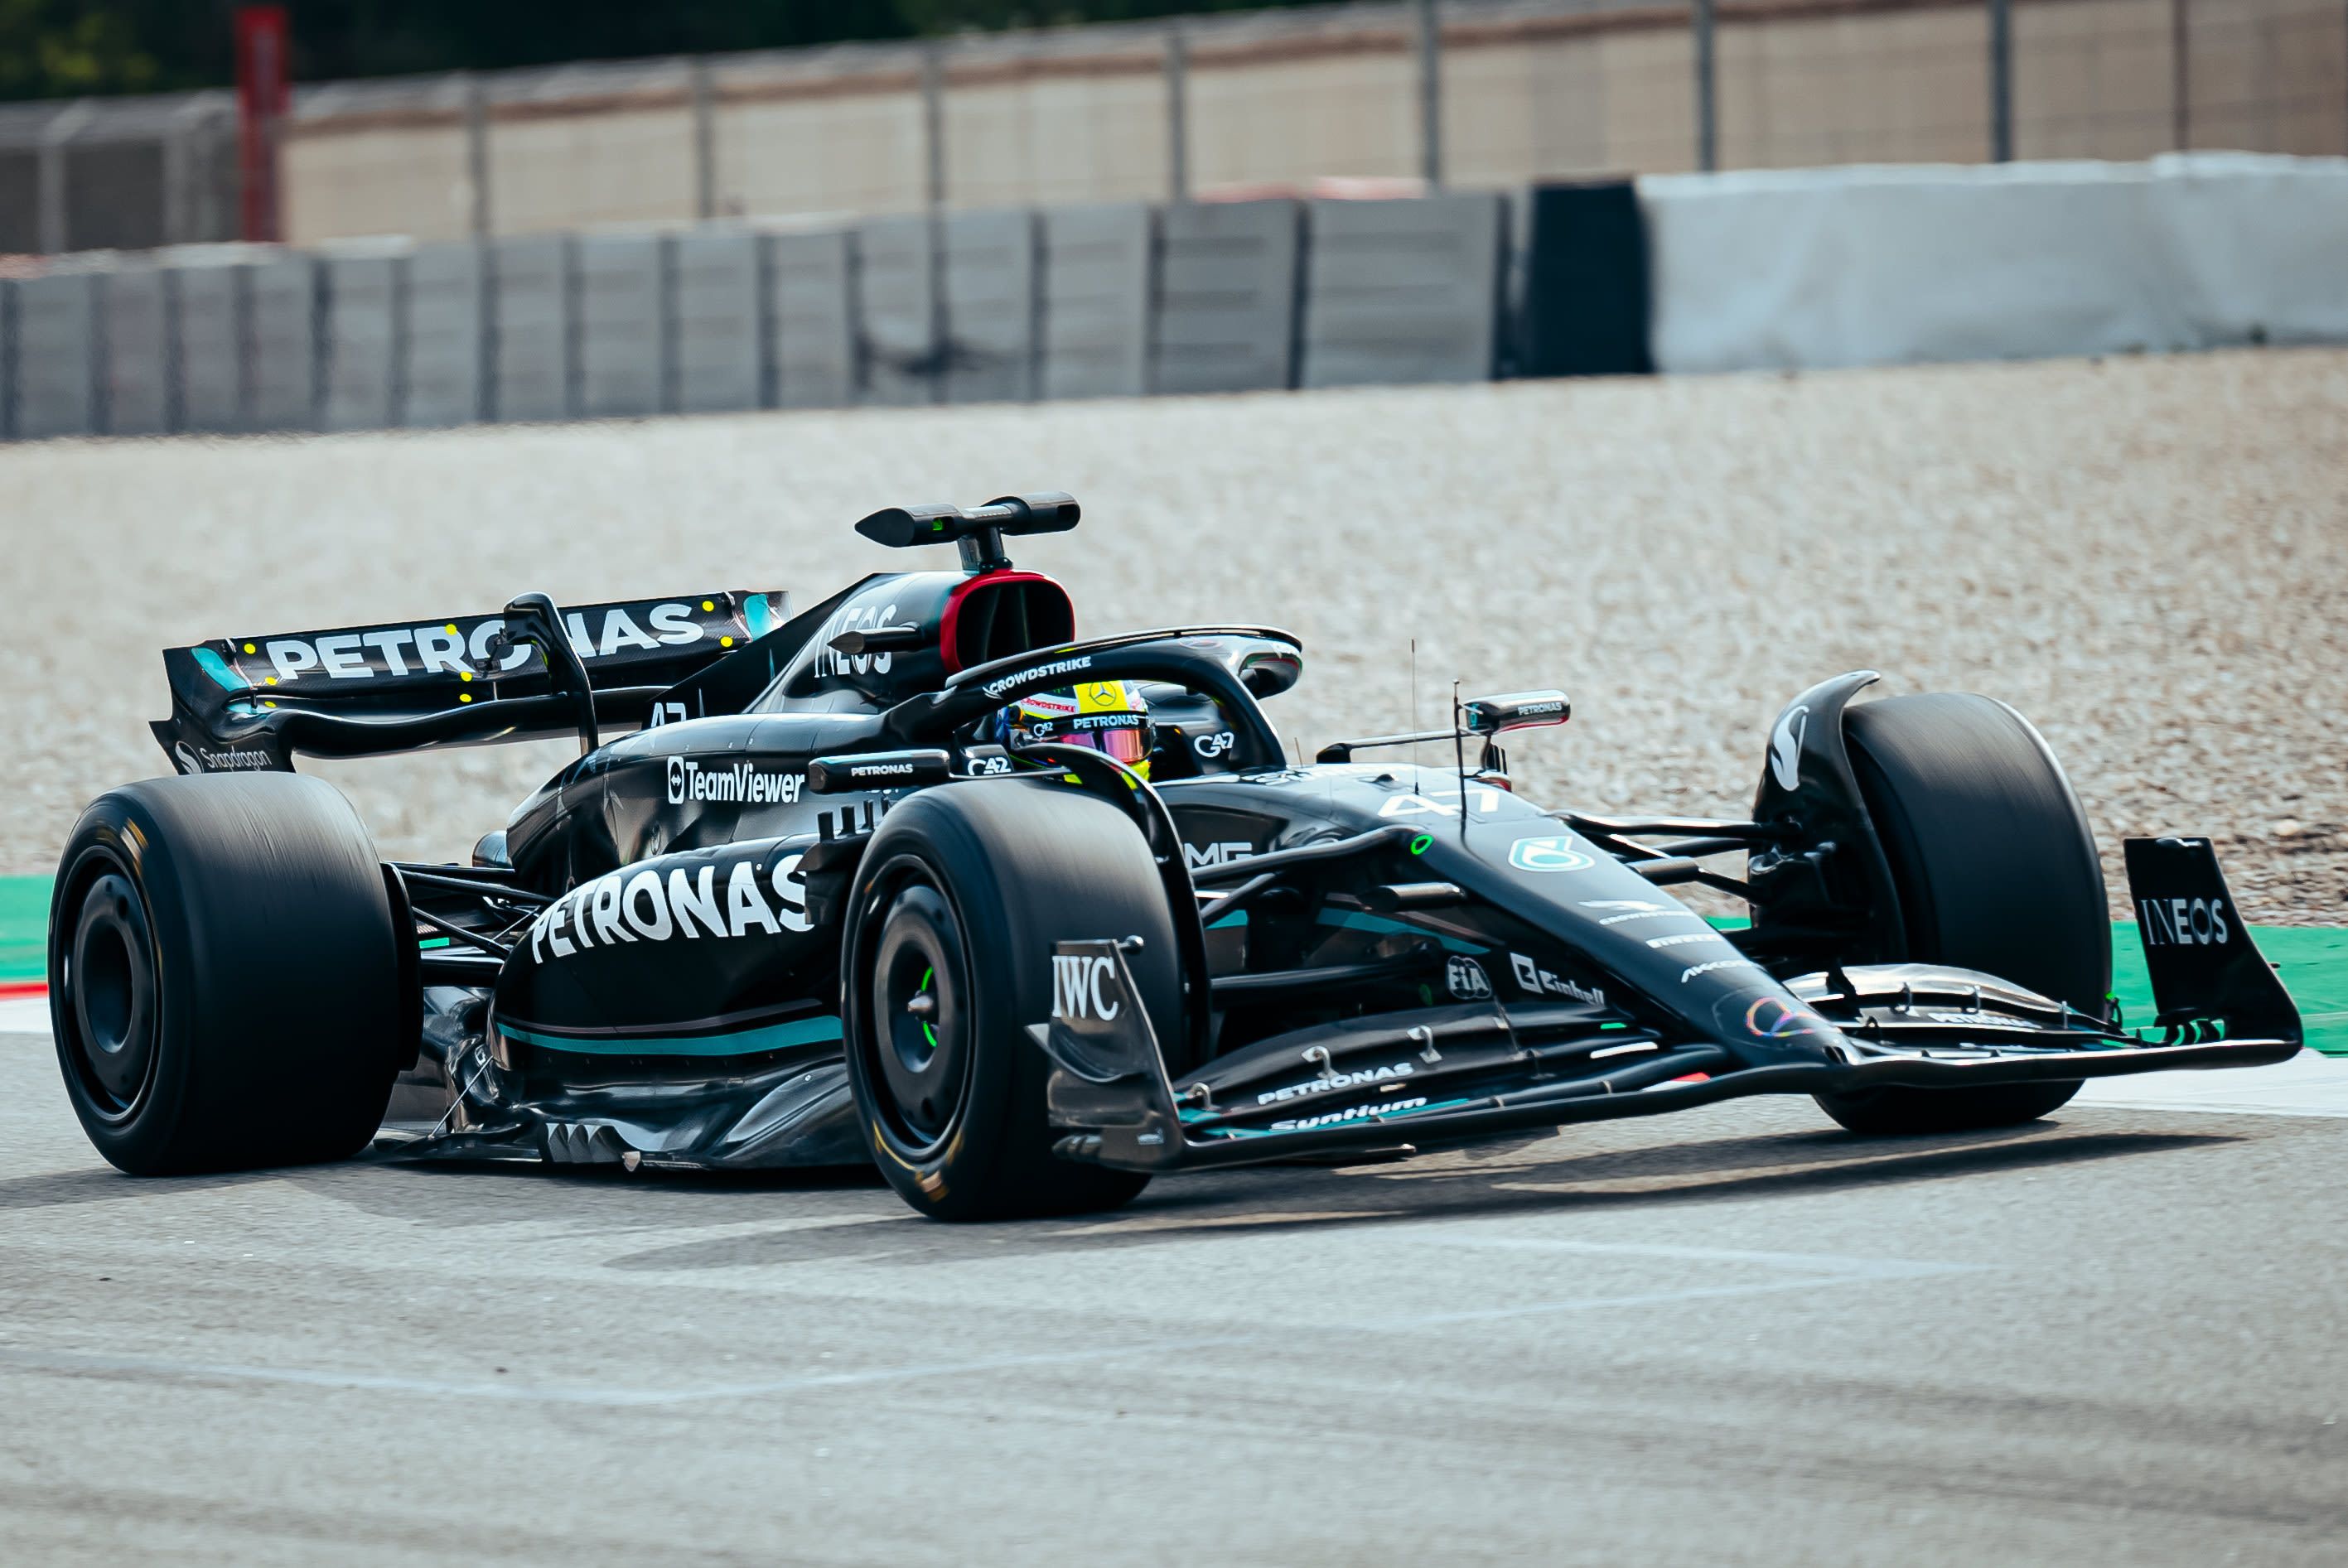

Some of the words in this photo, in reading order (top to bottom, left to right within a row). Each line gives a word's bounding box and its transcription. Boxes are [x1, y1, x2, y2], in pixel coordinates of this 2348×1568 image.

[989, 656, 1091, 693] CROWDSTRIKE
[1073, 715, 1139, 730] PETRONAS
[1518, 702, 1563, 716] PETRONAS
[200, 745, 273, 771] Snapdragon
[851, 764, 913, 777] PETRONAS
[685, 762, 805, 803] TeamViewer
[1183, 842, 1254, 871] MG
[531, 854, 815, 964] PETRONAS
[2139, 898, 2228, 944] INEOS
[1051, 956, 1119, 1021] IWC
[1257, 1062, 1414, 1106] PETRONAS
